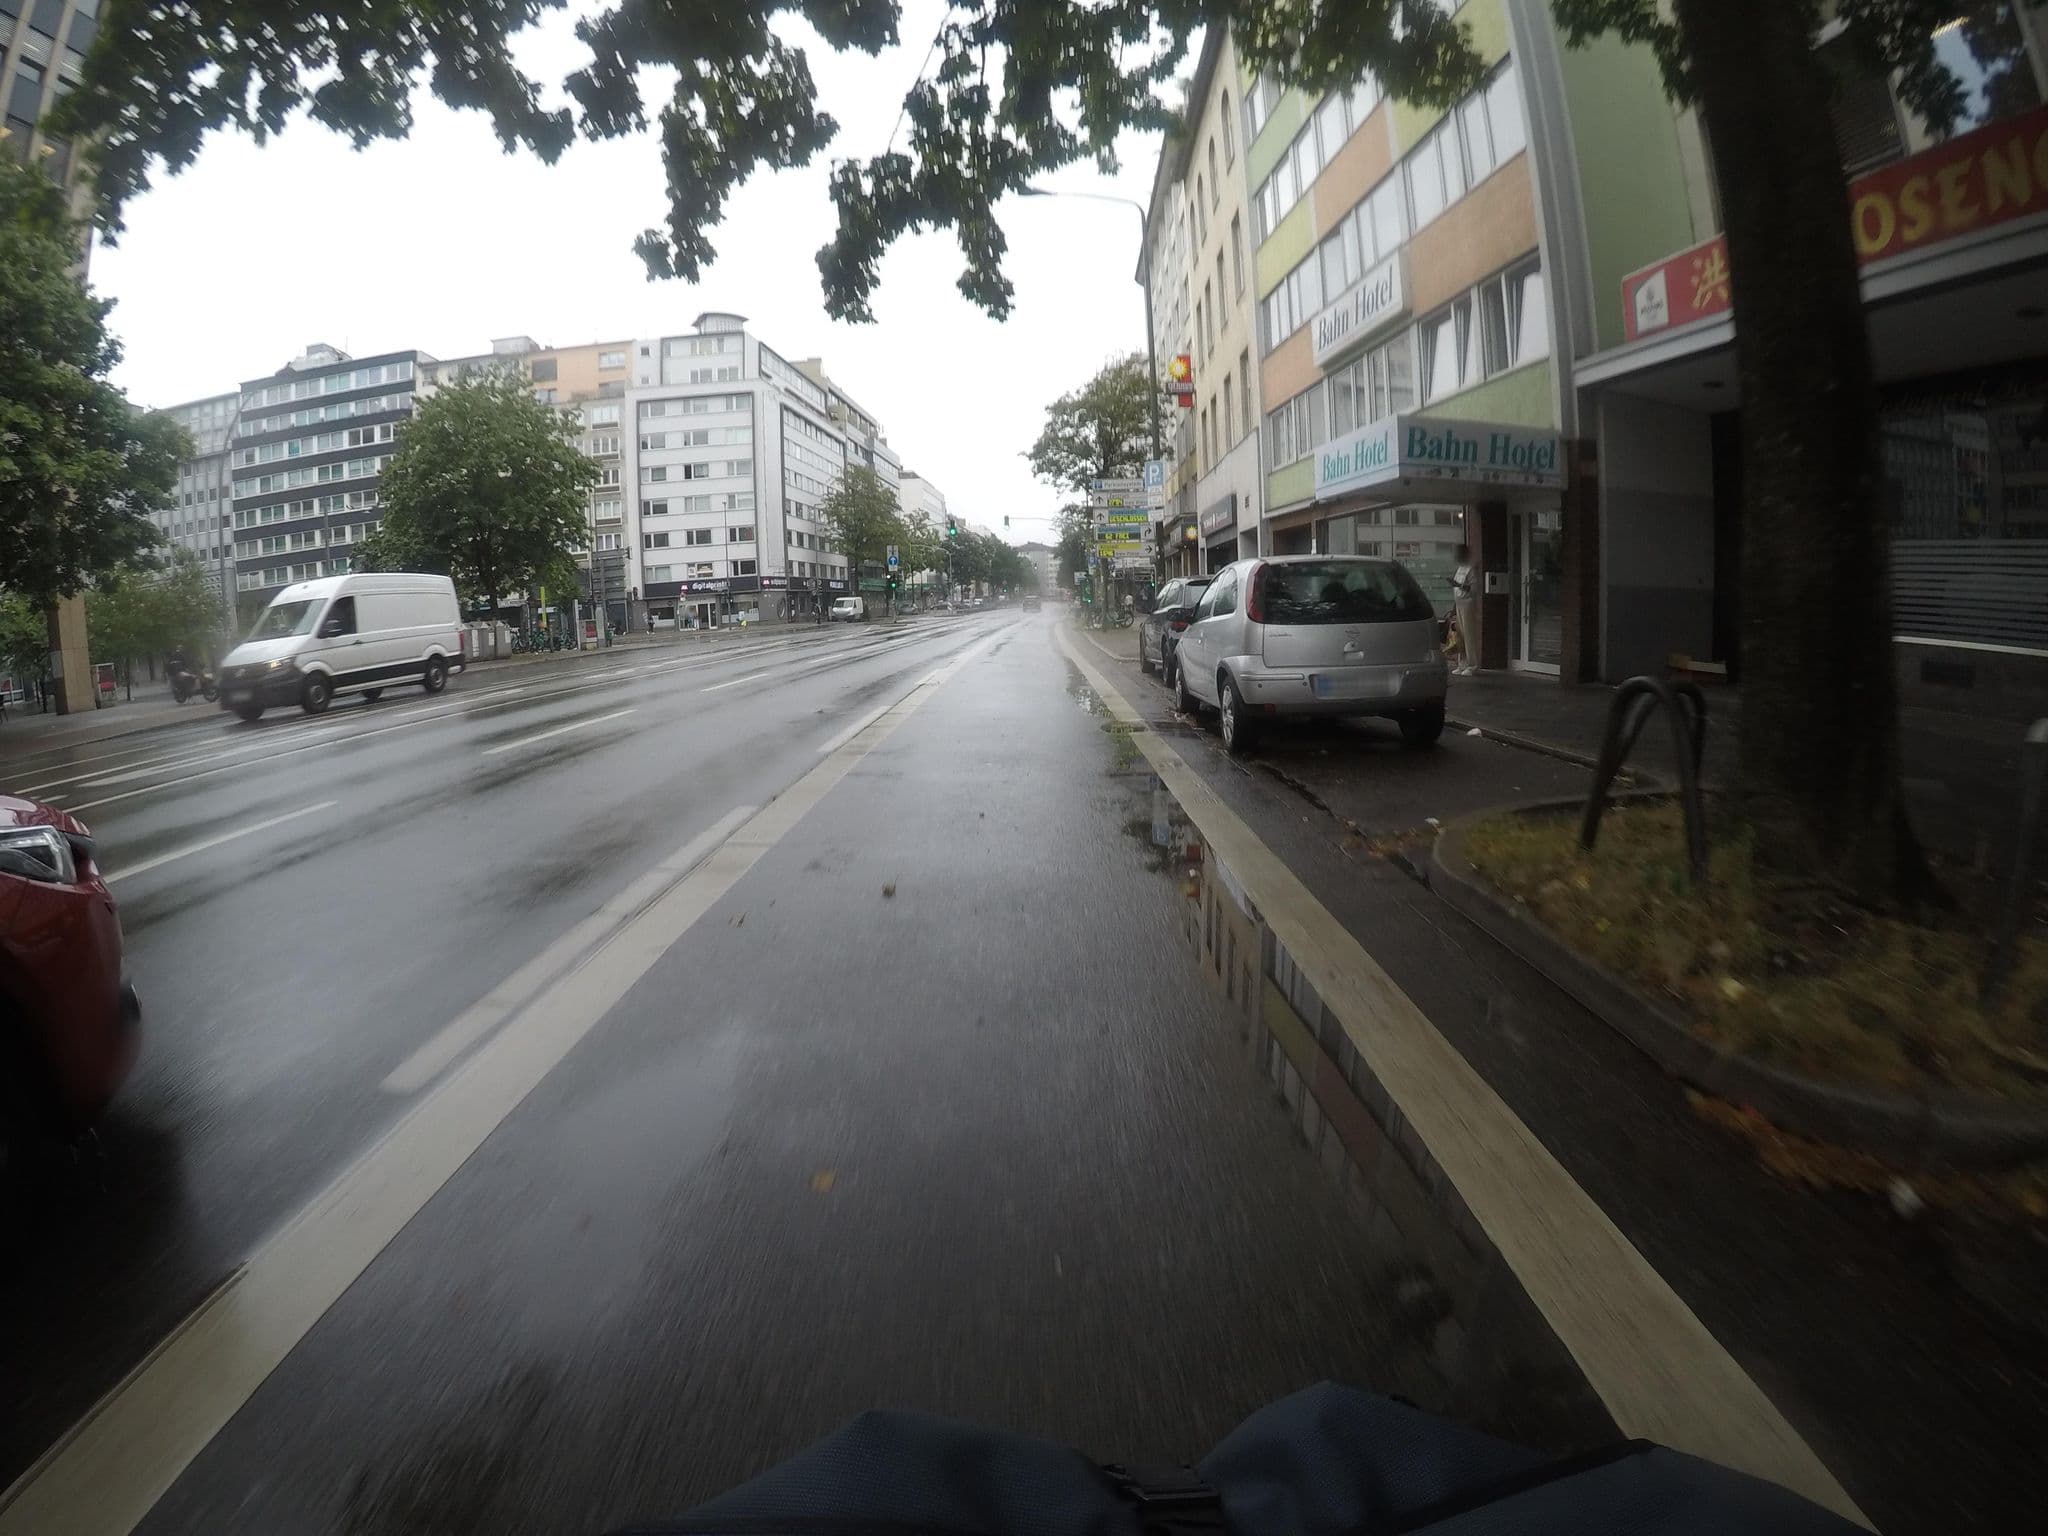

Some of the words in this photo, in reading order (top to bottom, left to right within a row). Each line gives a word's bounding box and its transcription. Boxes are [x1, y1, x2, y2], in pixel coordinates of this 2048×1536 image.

[1318, 309, 1350, 350] Bahn
[1354, 264, 1394, 325] Hotel
[1322, 454, 1351, 481] Bahn
[1354, 432, 1389, 472] Hotel
[1408, 426, 1478, 463] Bahn
[1488, 434, 1556, 470] Hotel
